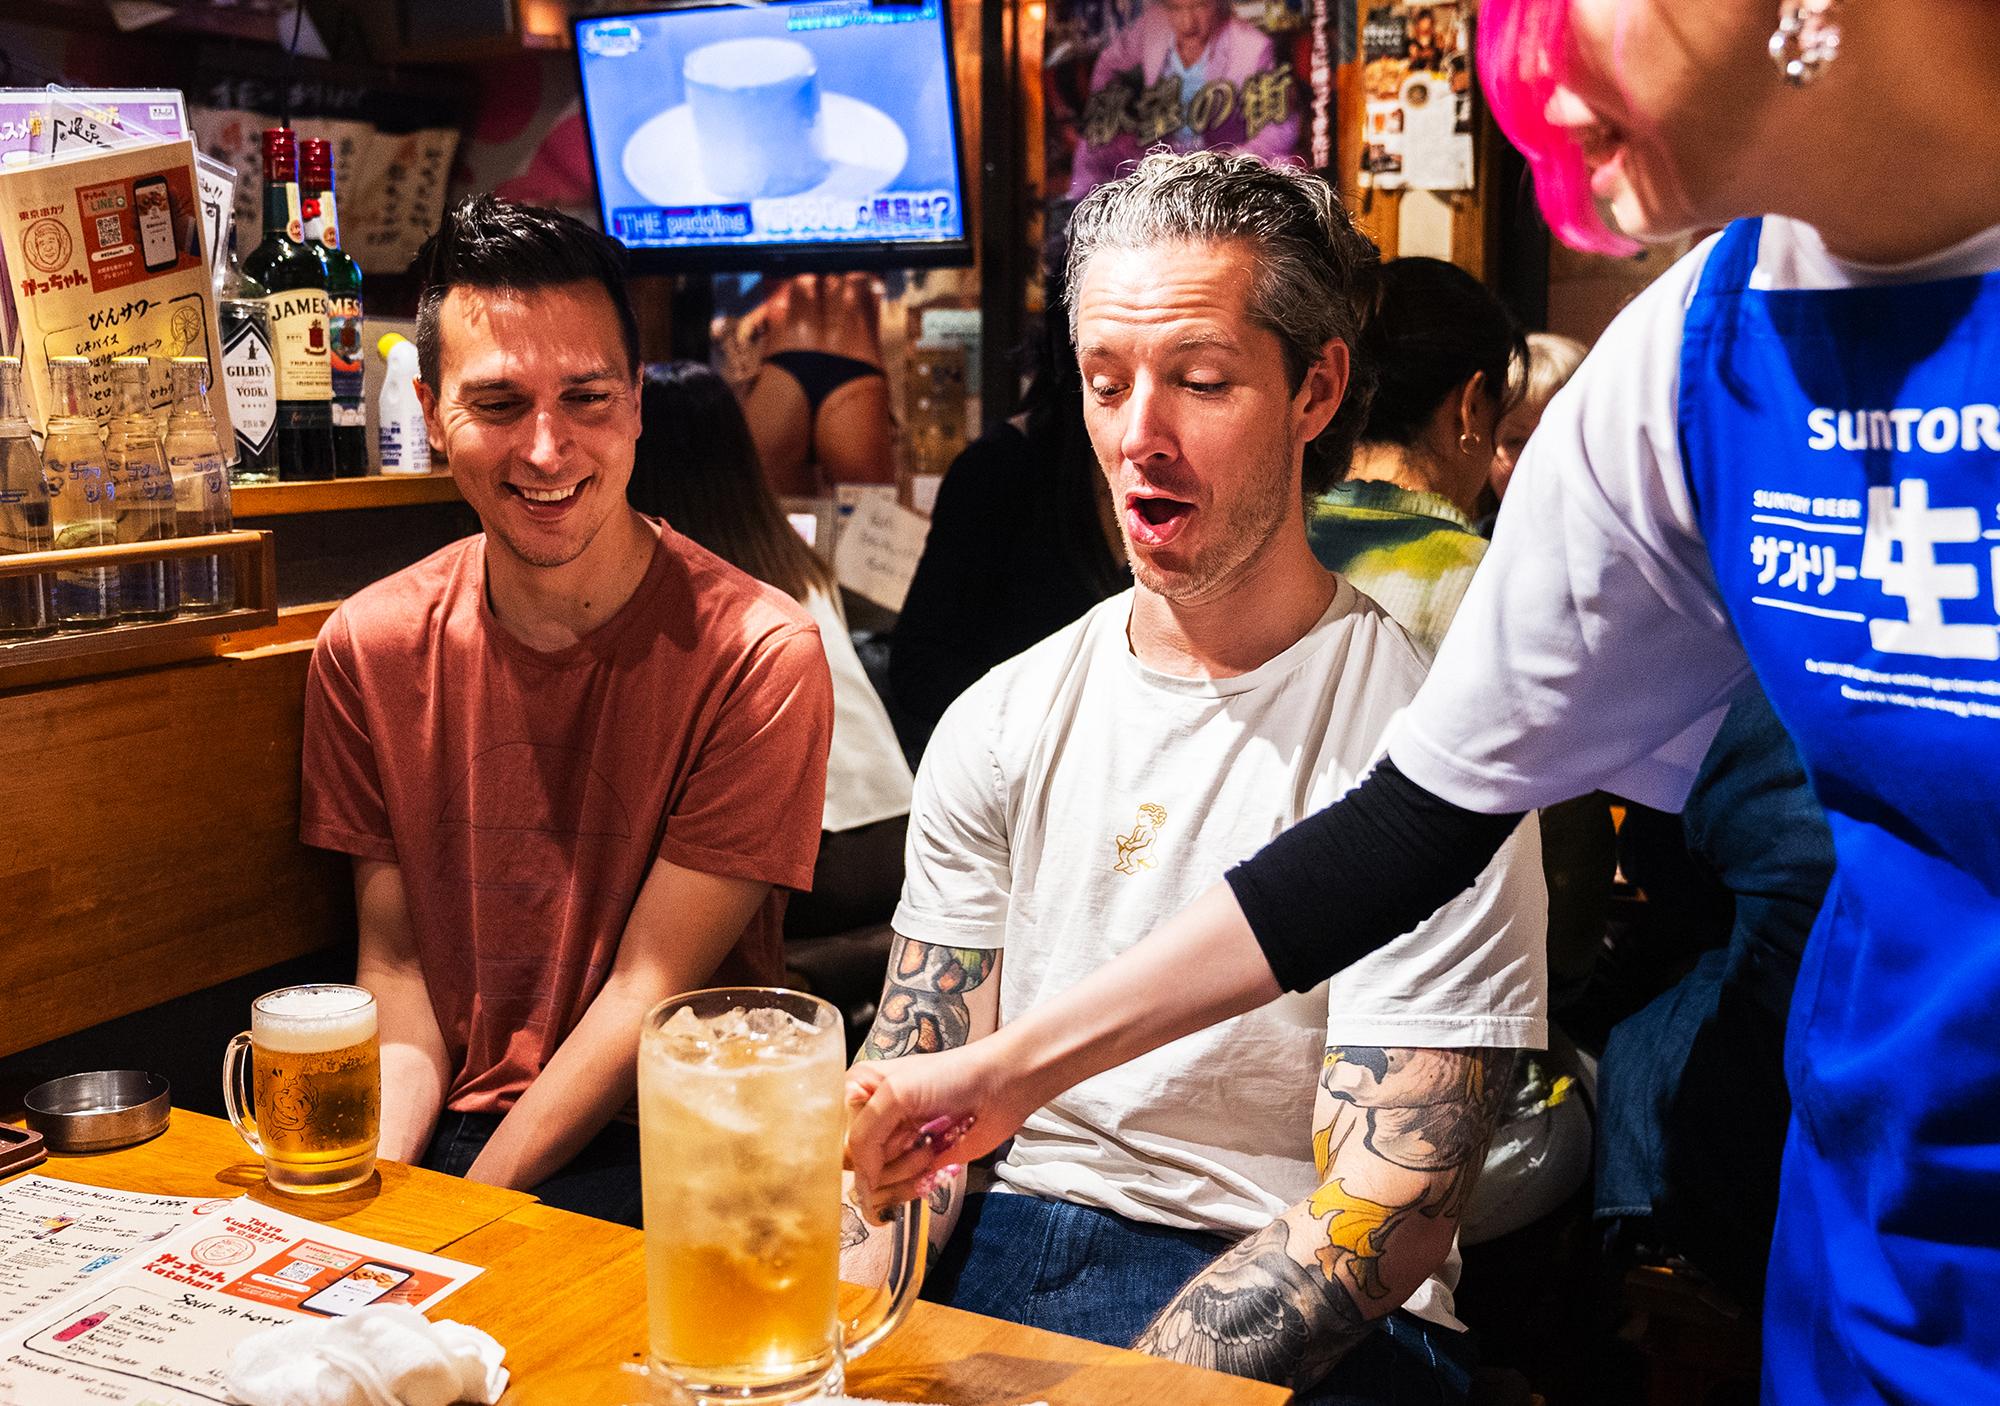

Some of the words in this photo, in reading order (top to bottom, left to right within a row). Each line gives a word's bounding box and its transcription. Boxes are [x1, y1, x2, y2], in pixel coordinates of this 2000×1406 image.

[18, 203, 65, 221] 東京串カツ
[21, 269, 88, 298] かっちゃん
[88, 300, 162, 331] びんサワー
[75, 333, 120, 355] しそバイス
[226, 364, 271, 377] GILBEY'S
[236, 385, 269, 397] VODKA
[1807, 403, 2000, 454] SUNTOR
[1752, 489, 1811, 515] SUNTORY
[1811, 497, 1862, 519] BEER
[1750, 535, 1858, 596] サントリー
[1859, 478, 2000, 662] 生
[223, 1216, 290, 1243] Kushikatsu
[248, 1217, 283, 1233] Tokyo
[142, 1262, 216, 1291] Katchan
[155, 1253, 228, 1283] かっちゃん
[174, 1293, 216, 1310] Sour
[219, 1305, 238, 1316] in
[240, 1310, 293, 1327] bottl
